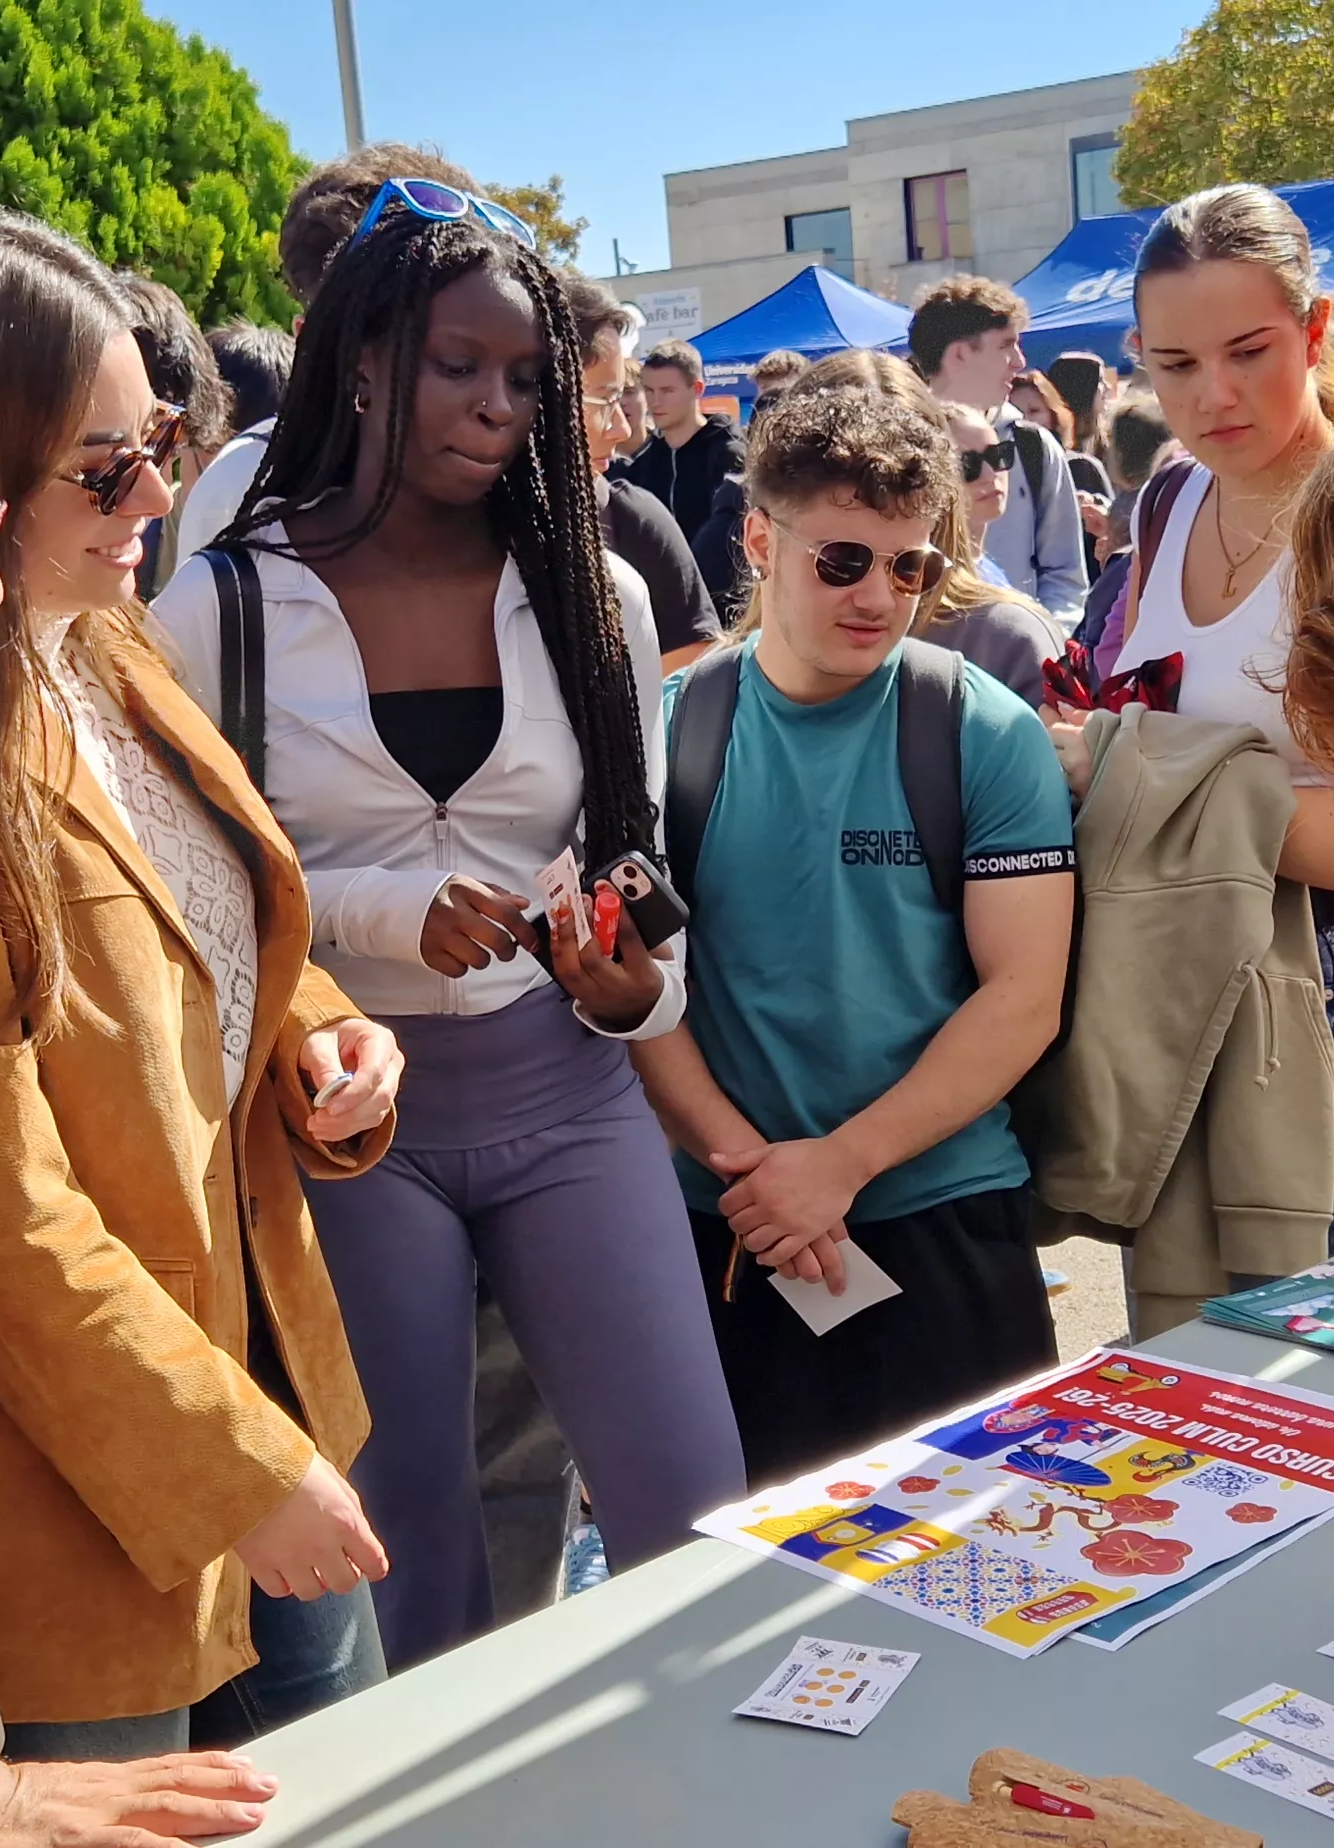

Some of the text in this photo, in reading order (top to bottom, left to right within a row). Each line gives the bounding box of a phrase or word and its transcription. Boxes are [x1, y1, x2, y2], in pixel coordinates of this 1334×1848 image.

[647, 306, 698, 322] afé bar
[964, 850, 1063, 873] ISCONNECTED
[1052, 1386, 1185, 1430] 2025-26!
[1251, 1402, 1309, 1423] barrera
[1229, 1412, 1280, 1430] idioma
[1278, 1425, 1302, 1437] Un
[1171, 1421, 1260, 1453] CULM
